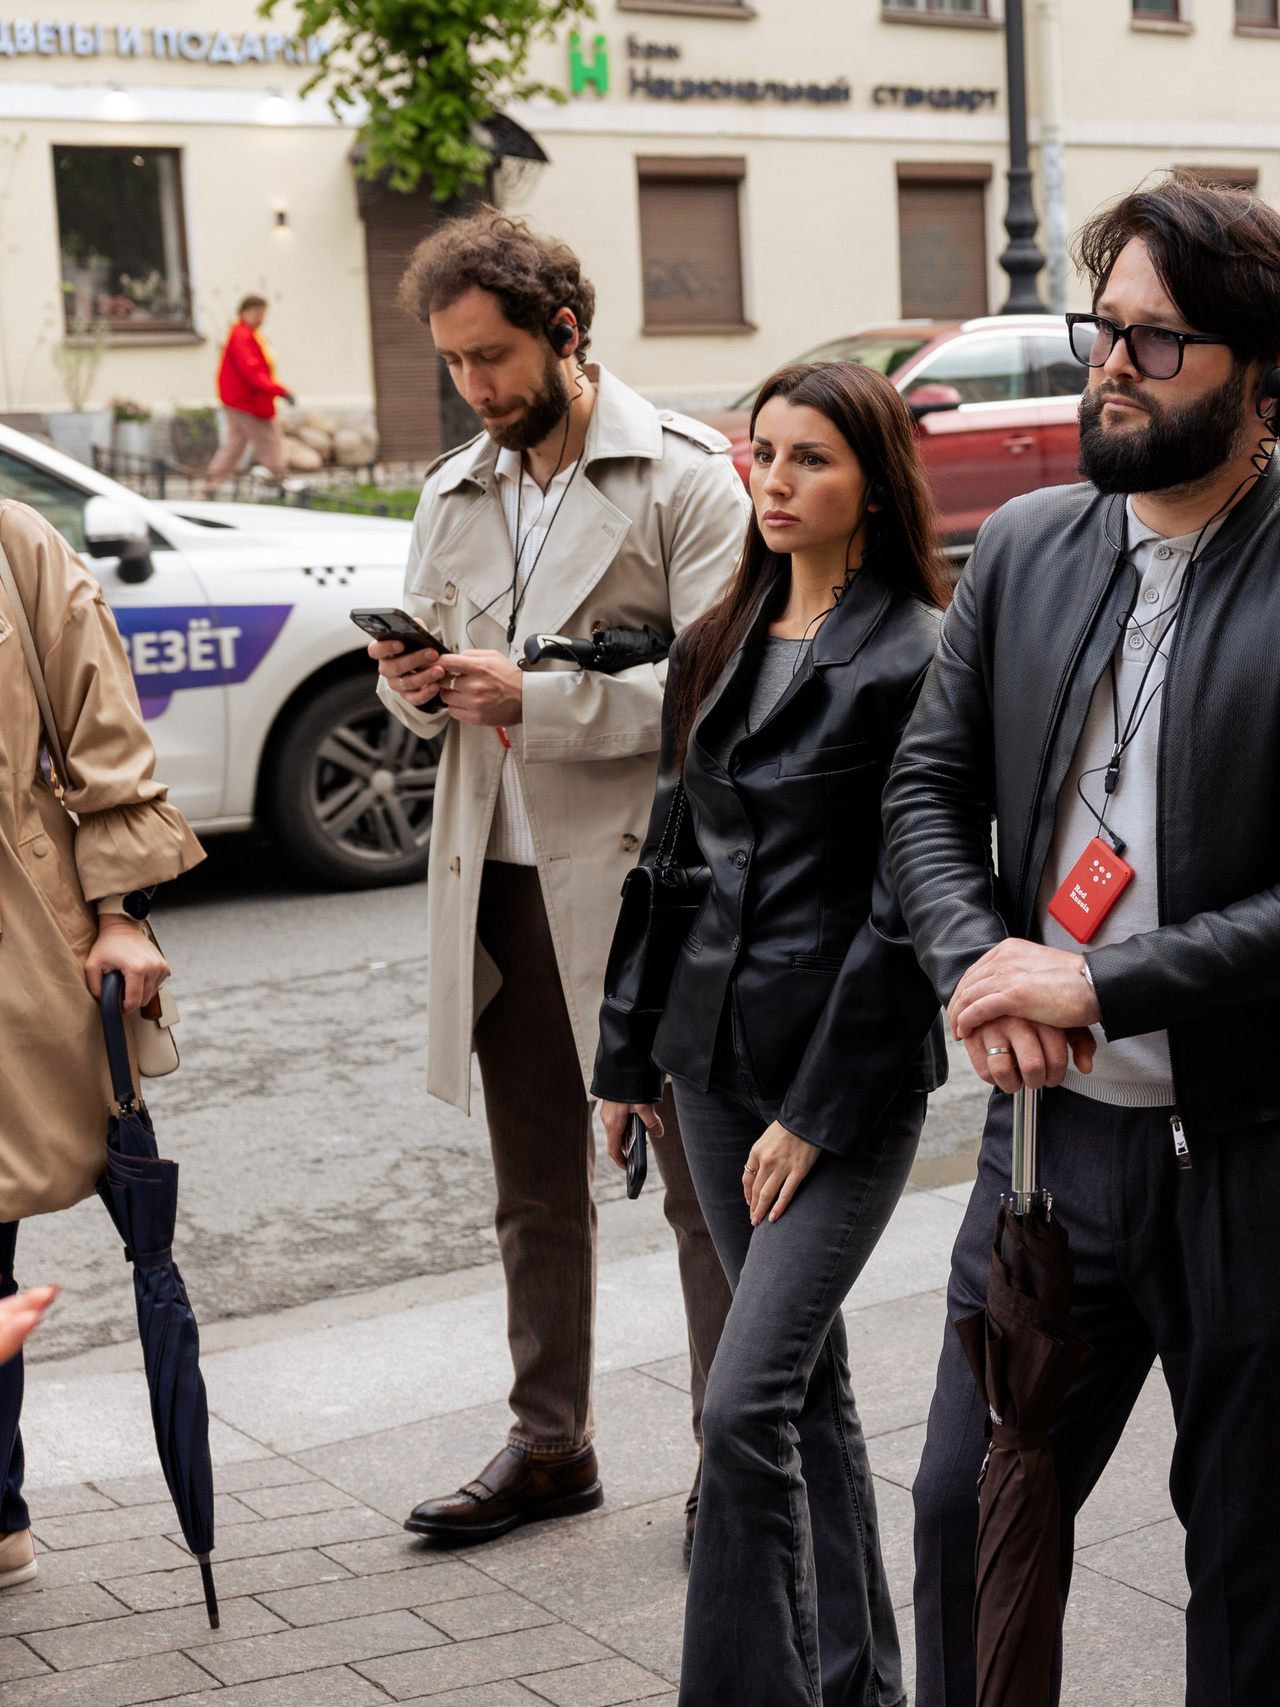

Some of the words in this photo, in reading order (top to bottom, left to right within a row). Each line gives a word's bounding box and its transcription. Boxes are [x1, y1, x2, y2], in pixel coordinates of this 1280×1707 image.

[116, 24, 142, 57] И
[629, 67, 851, 104] Национальный
[872, 84, 999, 113] стандарт
[120, 618, 242, 676] ЕЗЁТ
[1070, 891, 1090, 913] Russia
[1074, 884, 1087, 899] Red
